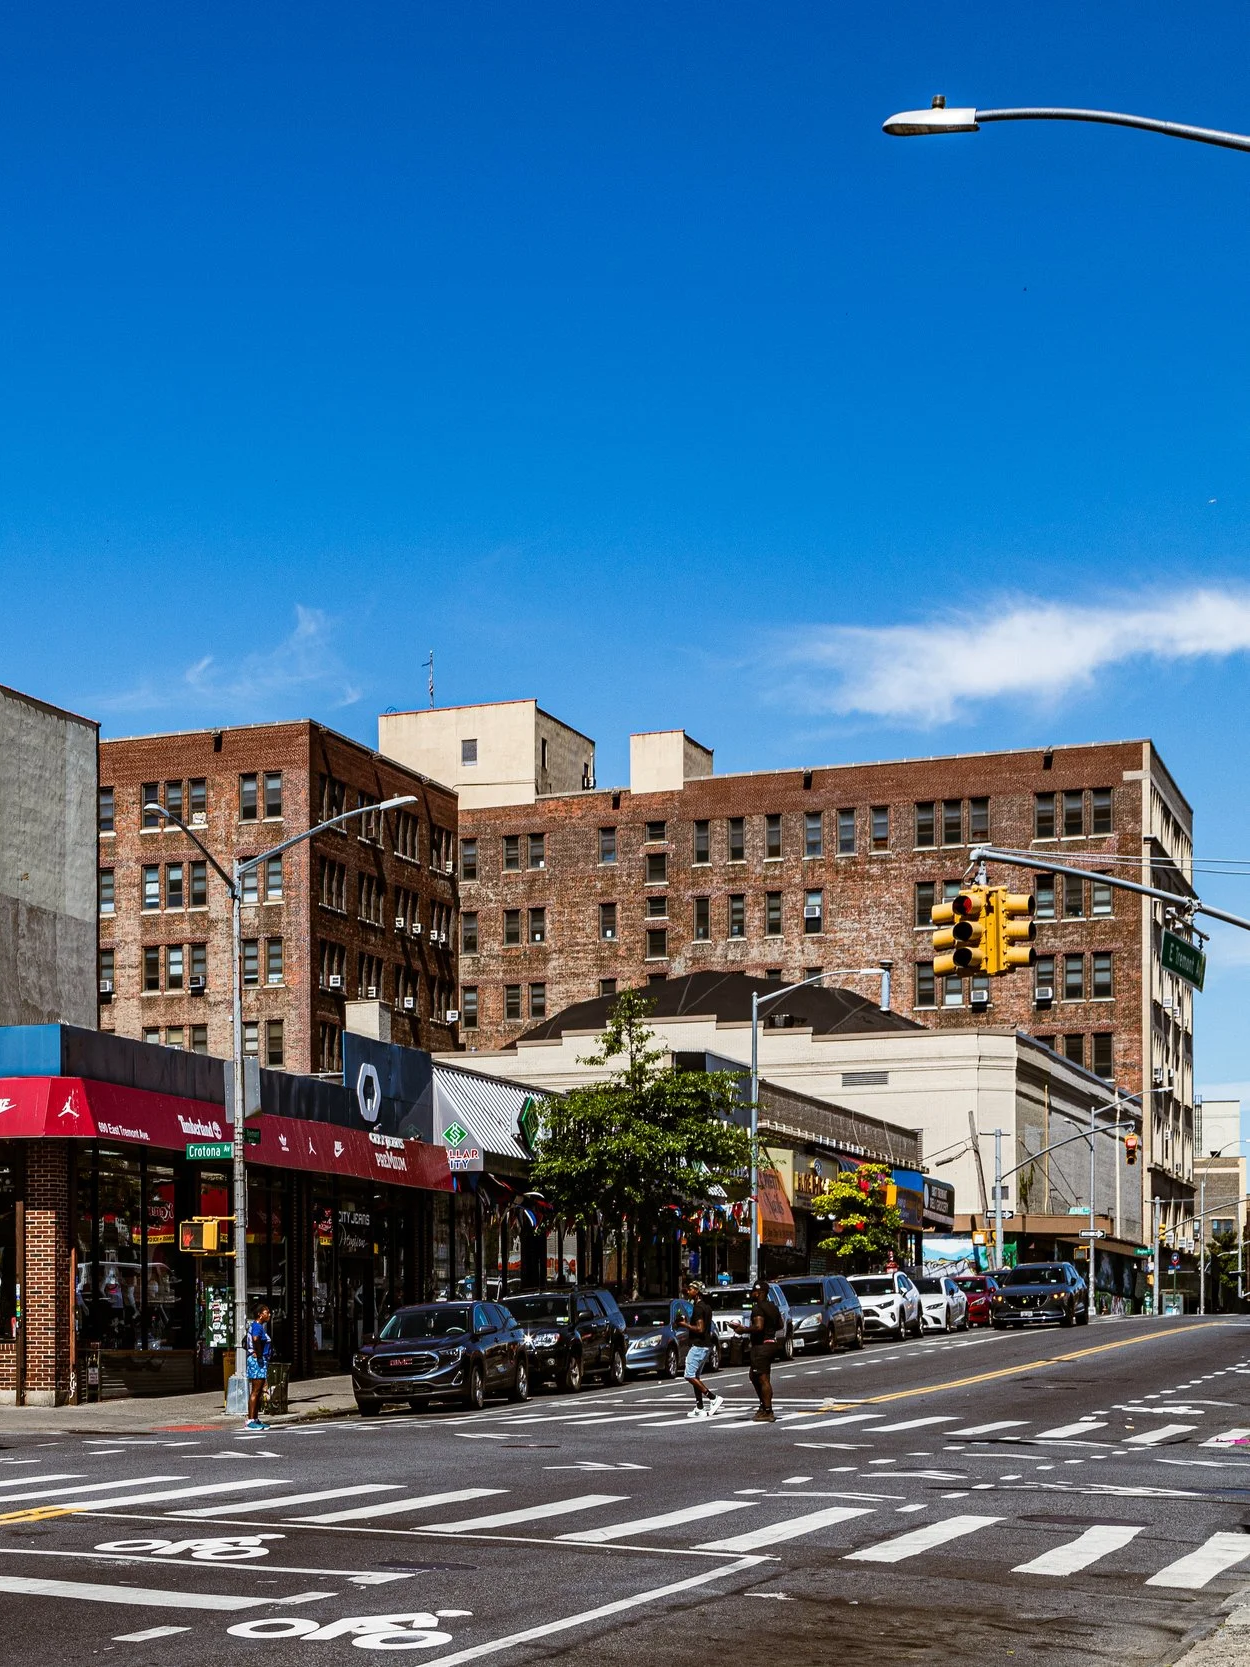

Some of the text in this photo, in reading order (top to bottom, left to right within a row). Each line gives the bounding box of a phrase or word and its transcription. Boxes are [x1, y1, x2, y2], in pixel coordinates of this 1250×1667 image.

[109, 1123, 121, 1136] East
[119, 1125, 139, 1138] Tremont
[177, 1114, 215, 1138] Timberland
[188, 1144, 231, 1158] Crotona Av
[374, 1150, 407, 1171] PREMIUM
[448, 1159, 469, 1169] ITY
[389, 1358, 413, 1366] GMC
